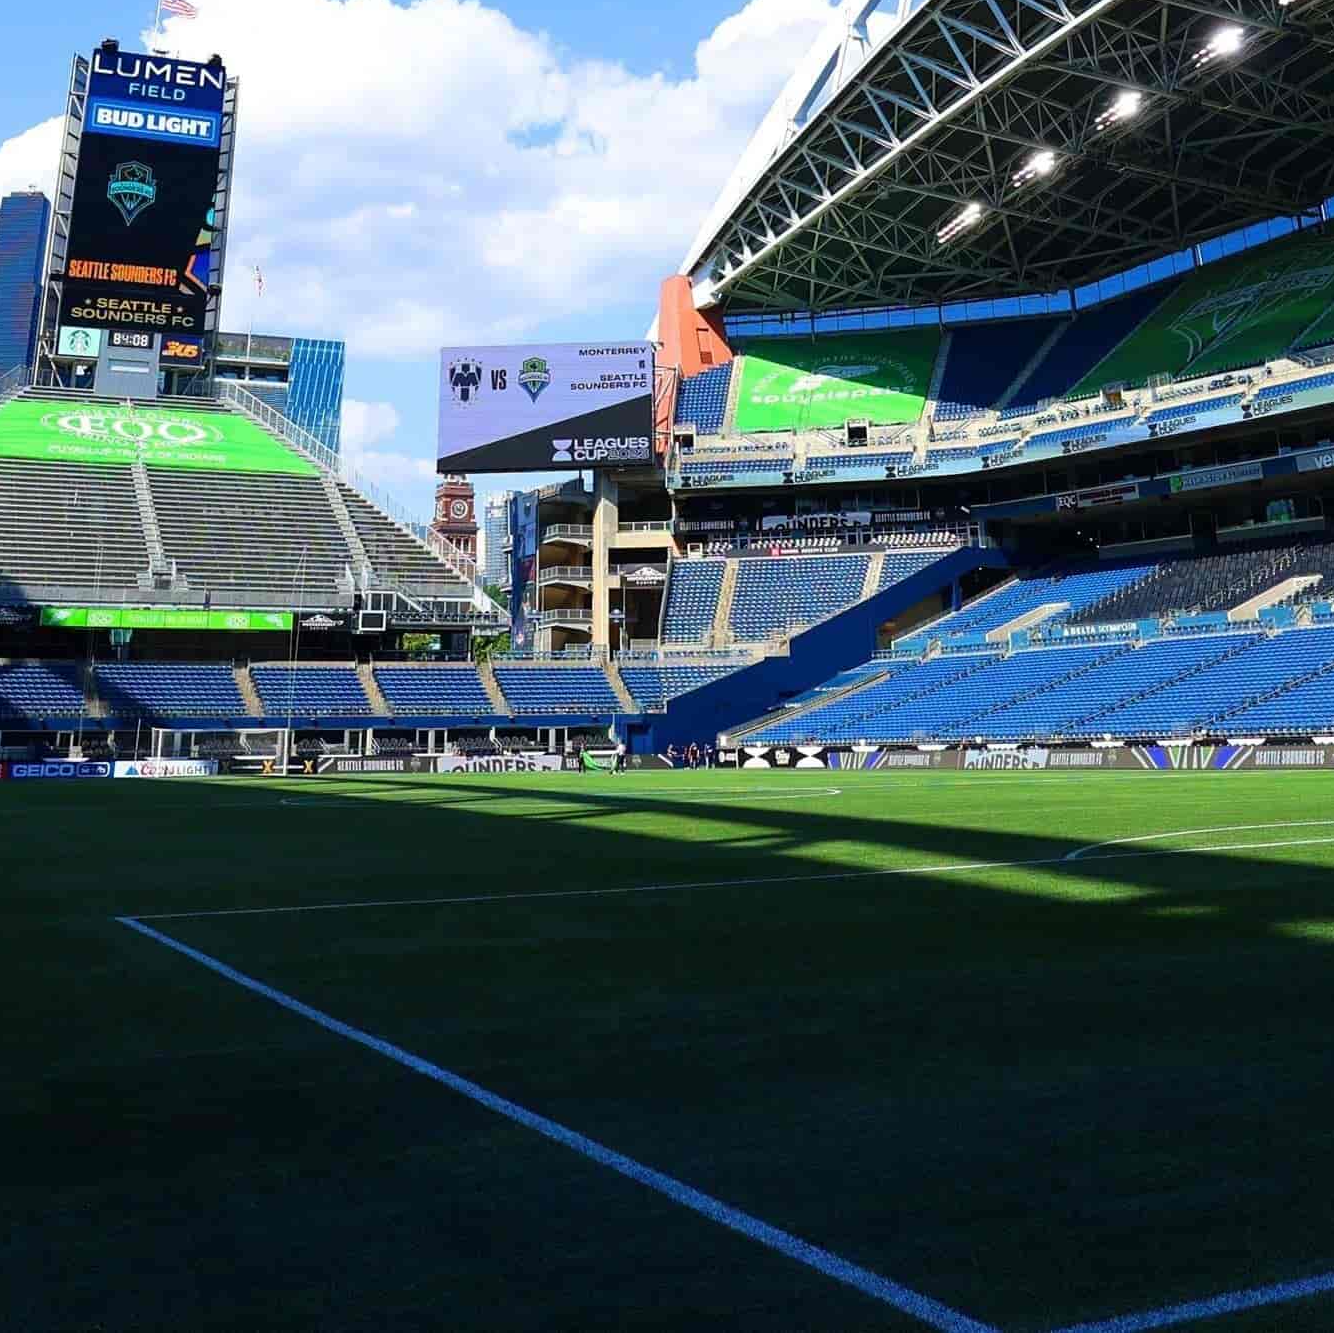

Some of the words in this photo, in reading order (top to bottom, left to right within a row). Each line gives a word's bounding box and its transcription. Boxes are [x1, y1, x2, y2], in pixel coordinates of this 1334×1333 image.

[94, 54, 224, 90] LUMEN
[128, 83, 186, 101] FIELD
[96, 108, 145, 128] BUD
[147, 114, 211, 137] LIGHT
[68, 259, 110, 281] SEATTLE
[110, 264, 163, 285] SOUNDERS
[164, 269, 177, 286] FC
[96, 297, 172, 314] SEATTLE
[70, 307, 167, 325] SOUNDERS
[172, 316, 195, 327] FC
[578, 347, 647, 356] MONTERREY
[490, 369, 507, 390] VS
[599, 373, 647, 382] SEATTLE
[570, 382, 630, 391] SOUNDERS
[632, 381, 647, 389] FC
[573, 437, 649, 450] LEAGUES
[573, 449, 608, 461] CUP
[1255, 750, 1280, 765] SEATTLE
[12, 764, 75, 777] GEICO
[176, 764, 209, 775] LIGHT
